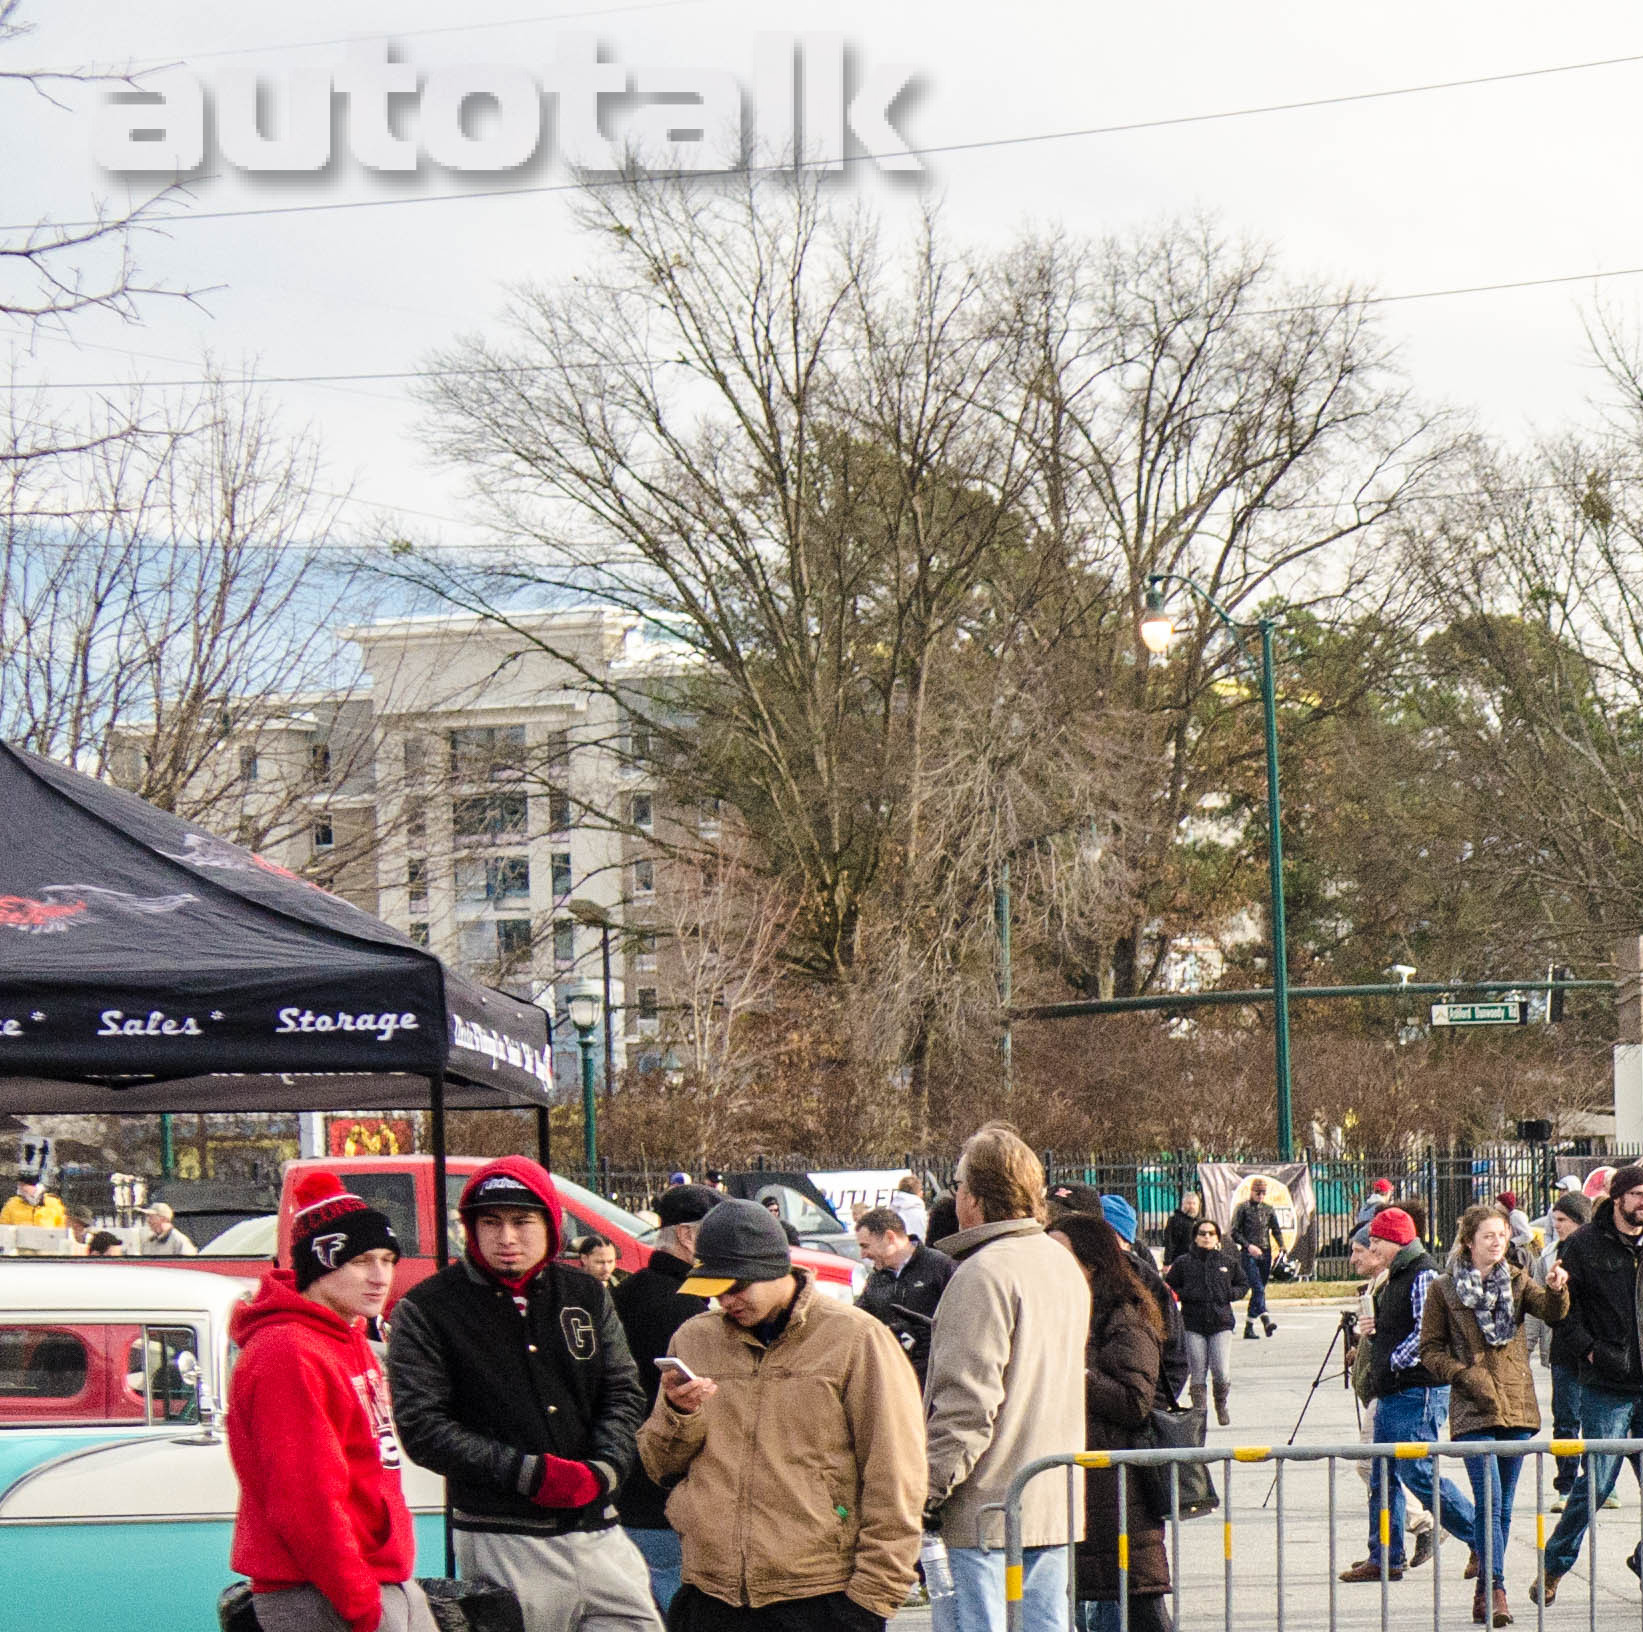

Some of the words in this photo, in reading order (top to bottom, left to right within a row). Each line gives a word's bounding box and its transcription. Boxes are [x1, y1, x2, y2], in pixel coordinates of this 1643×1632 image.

[97, 1009, 203, 1037] Sales
[275, 1006, 421, 1041] Storage
[560, 1307, 596, 1361] G
